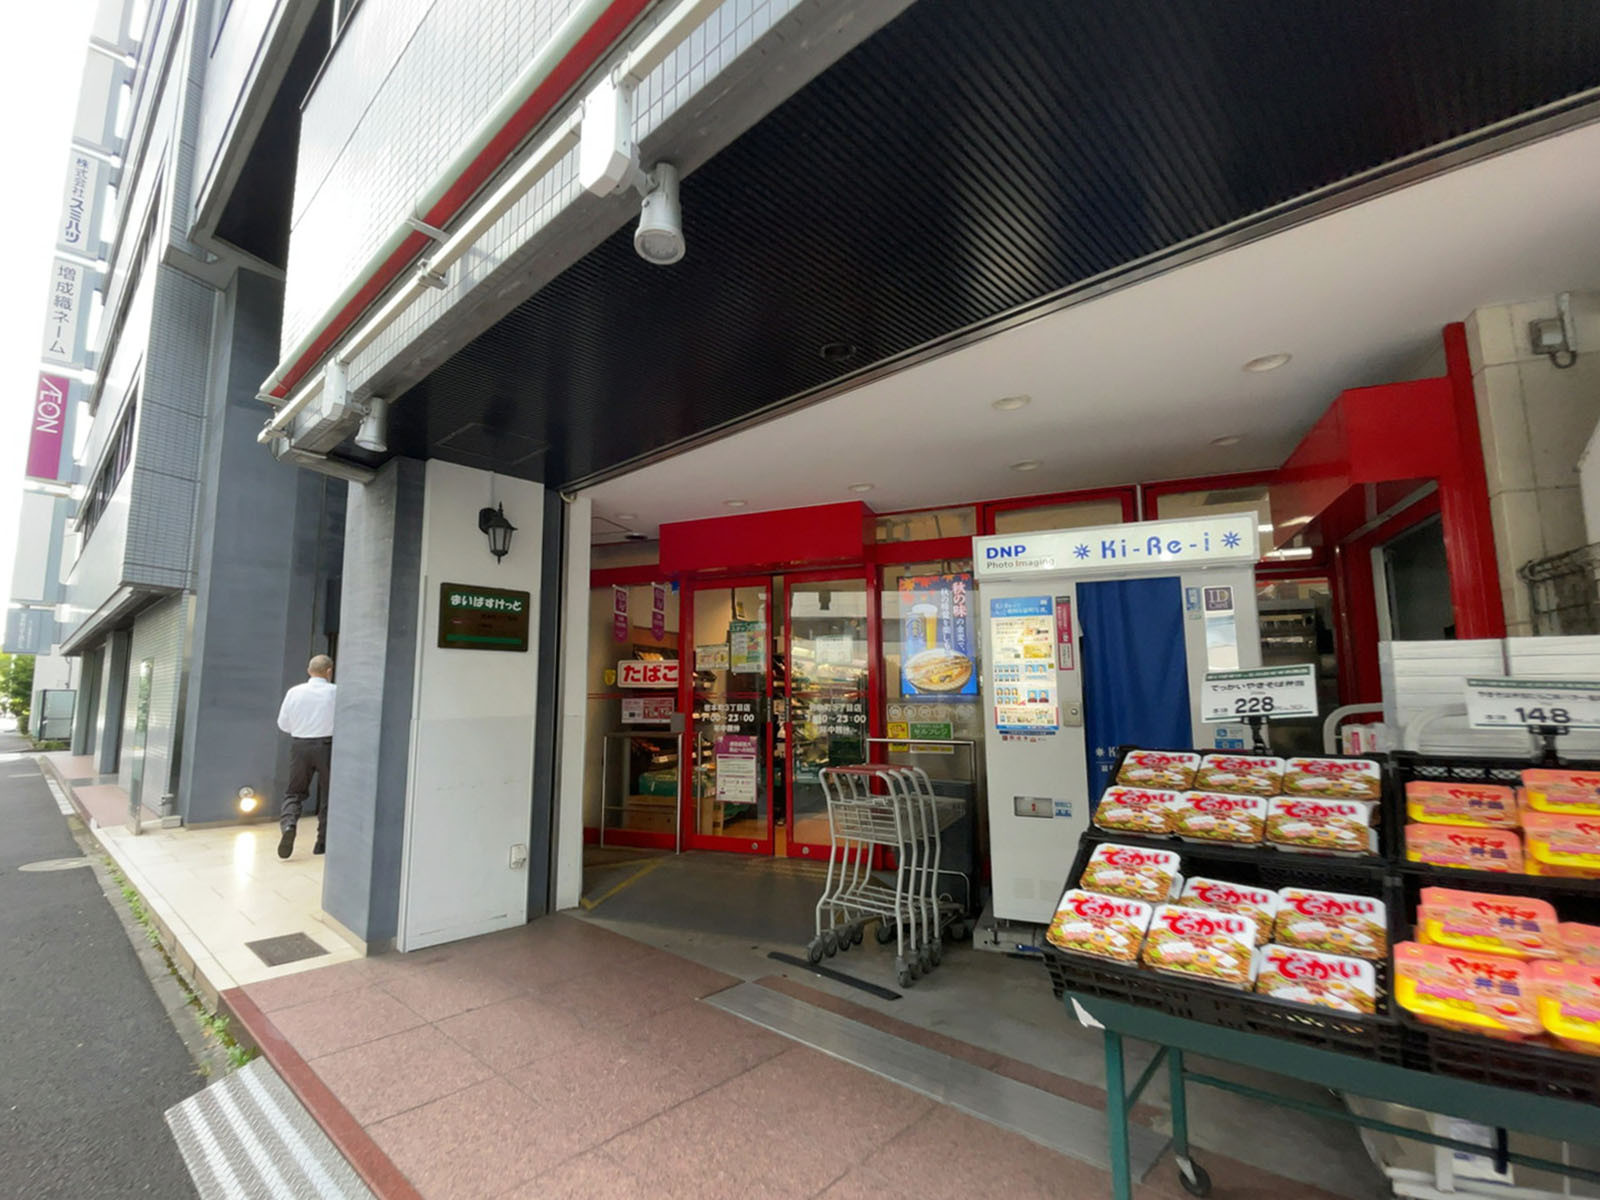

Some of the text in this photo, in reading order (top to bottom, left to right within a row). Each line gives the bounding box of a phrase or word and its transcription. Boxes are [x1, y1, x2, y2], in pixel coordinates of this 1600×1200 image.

[65, 158, 88, 243] 株式会社スミハツ
[49, 266, 76, 354] 増成織ネーム
[986, 544, 1026, 559] DNP
[986, 557, 1055, 570] Photo Imaging
[450, 594, 522, 611] まいばすけっと
[623, 664, 678, 682] たばこ
[1235, 696, 1274, 714] 228
[1515, 707, 1571, 723] 148
[1100, 849, 1170, 867] でっかい
[1190, 883, 1268, 904] でっかい
[1069, 896, 1141, 918] でっかい
[1286, 894, 1374, 917] でっかい
[1161, 913, 1245, 936] でっかい
[1267, 953, 1361, 980] でっかい
